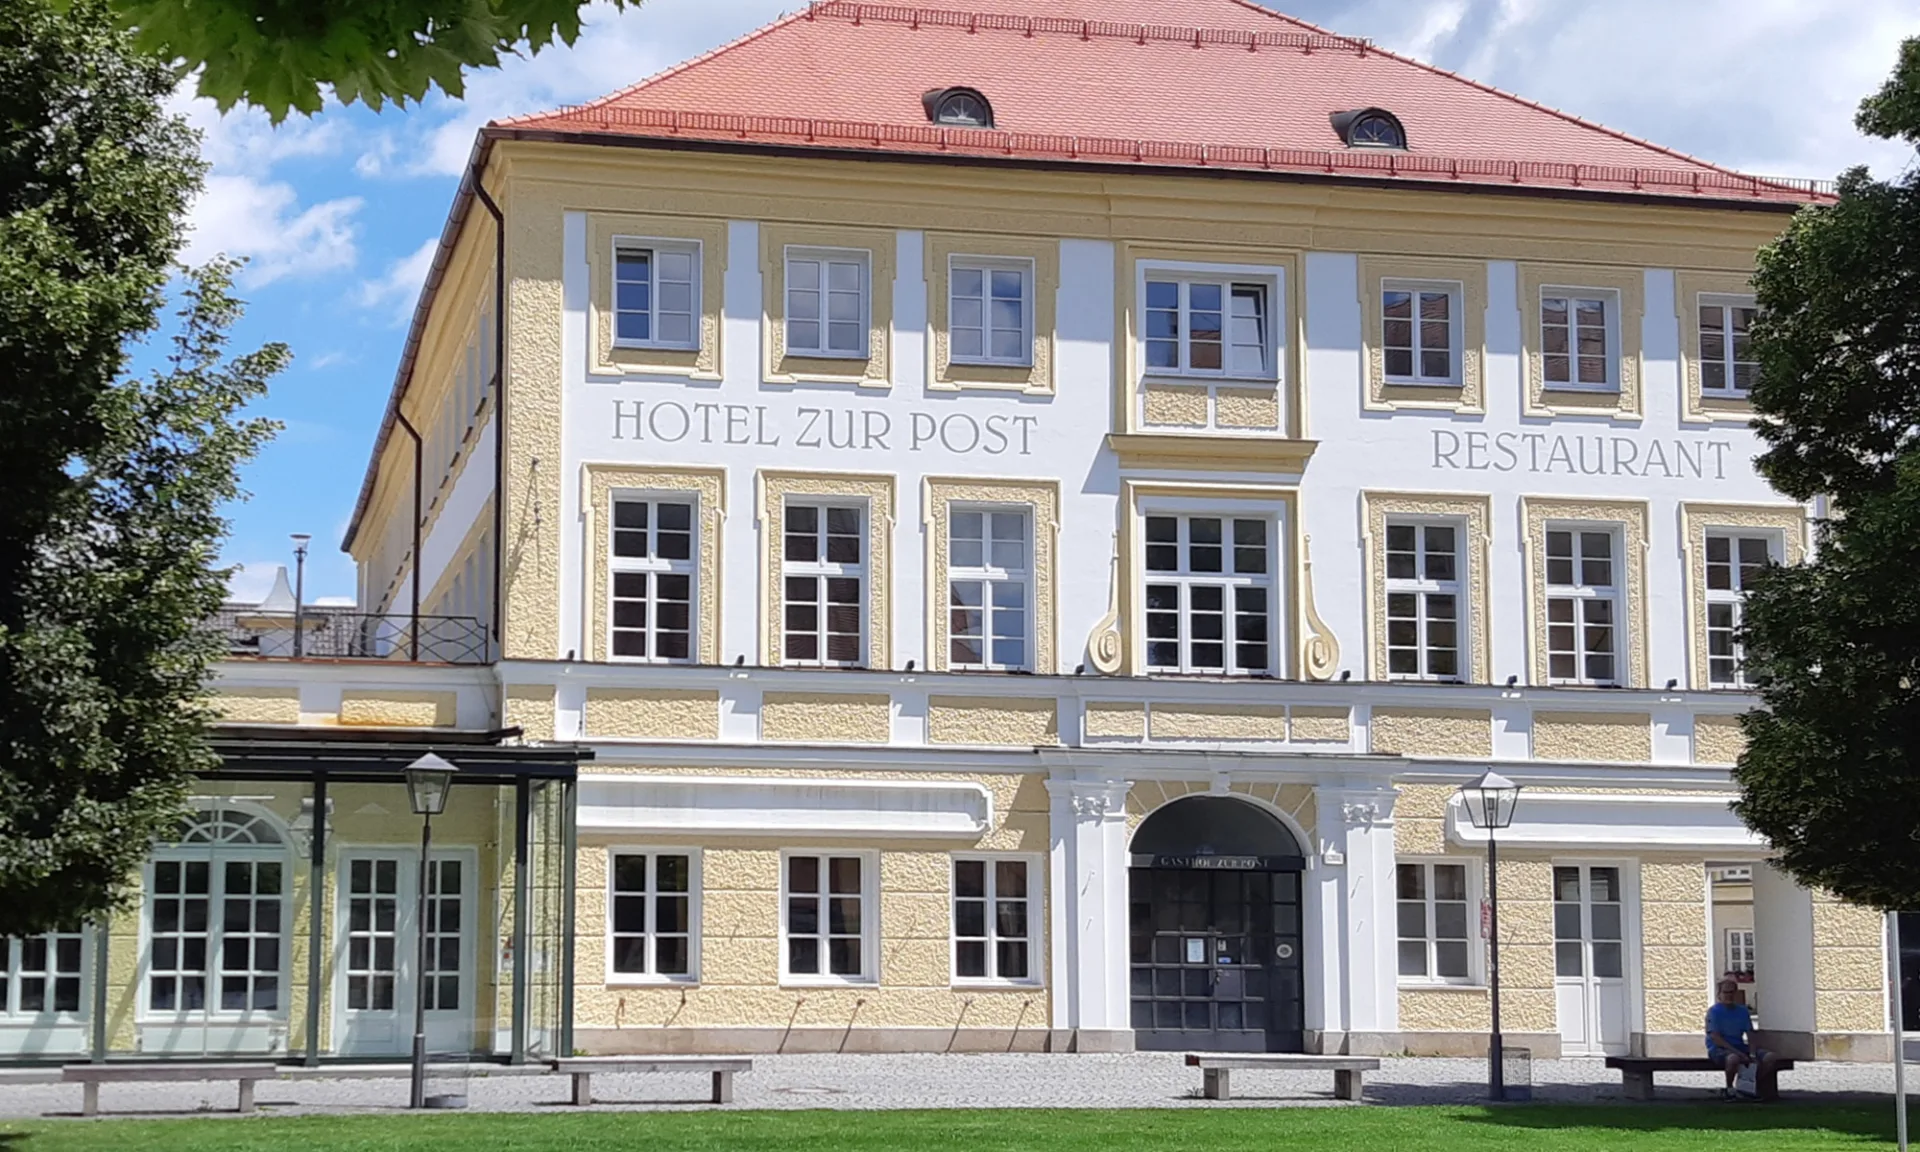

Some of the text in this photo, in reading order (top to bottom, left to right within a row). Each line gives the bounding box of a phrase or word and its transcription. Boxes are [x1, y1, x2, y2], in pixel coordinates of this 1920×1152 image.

[612, 400, 1038, 455] HOTEL ZUR POST
[1431, 430, 1731, 480] RESTAURANT
